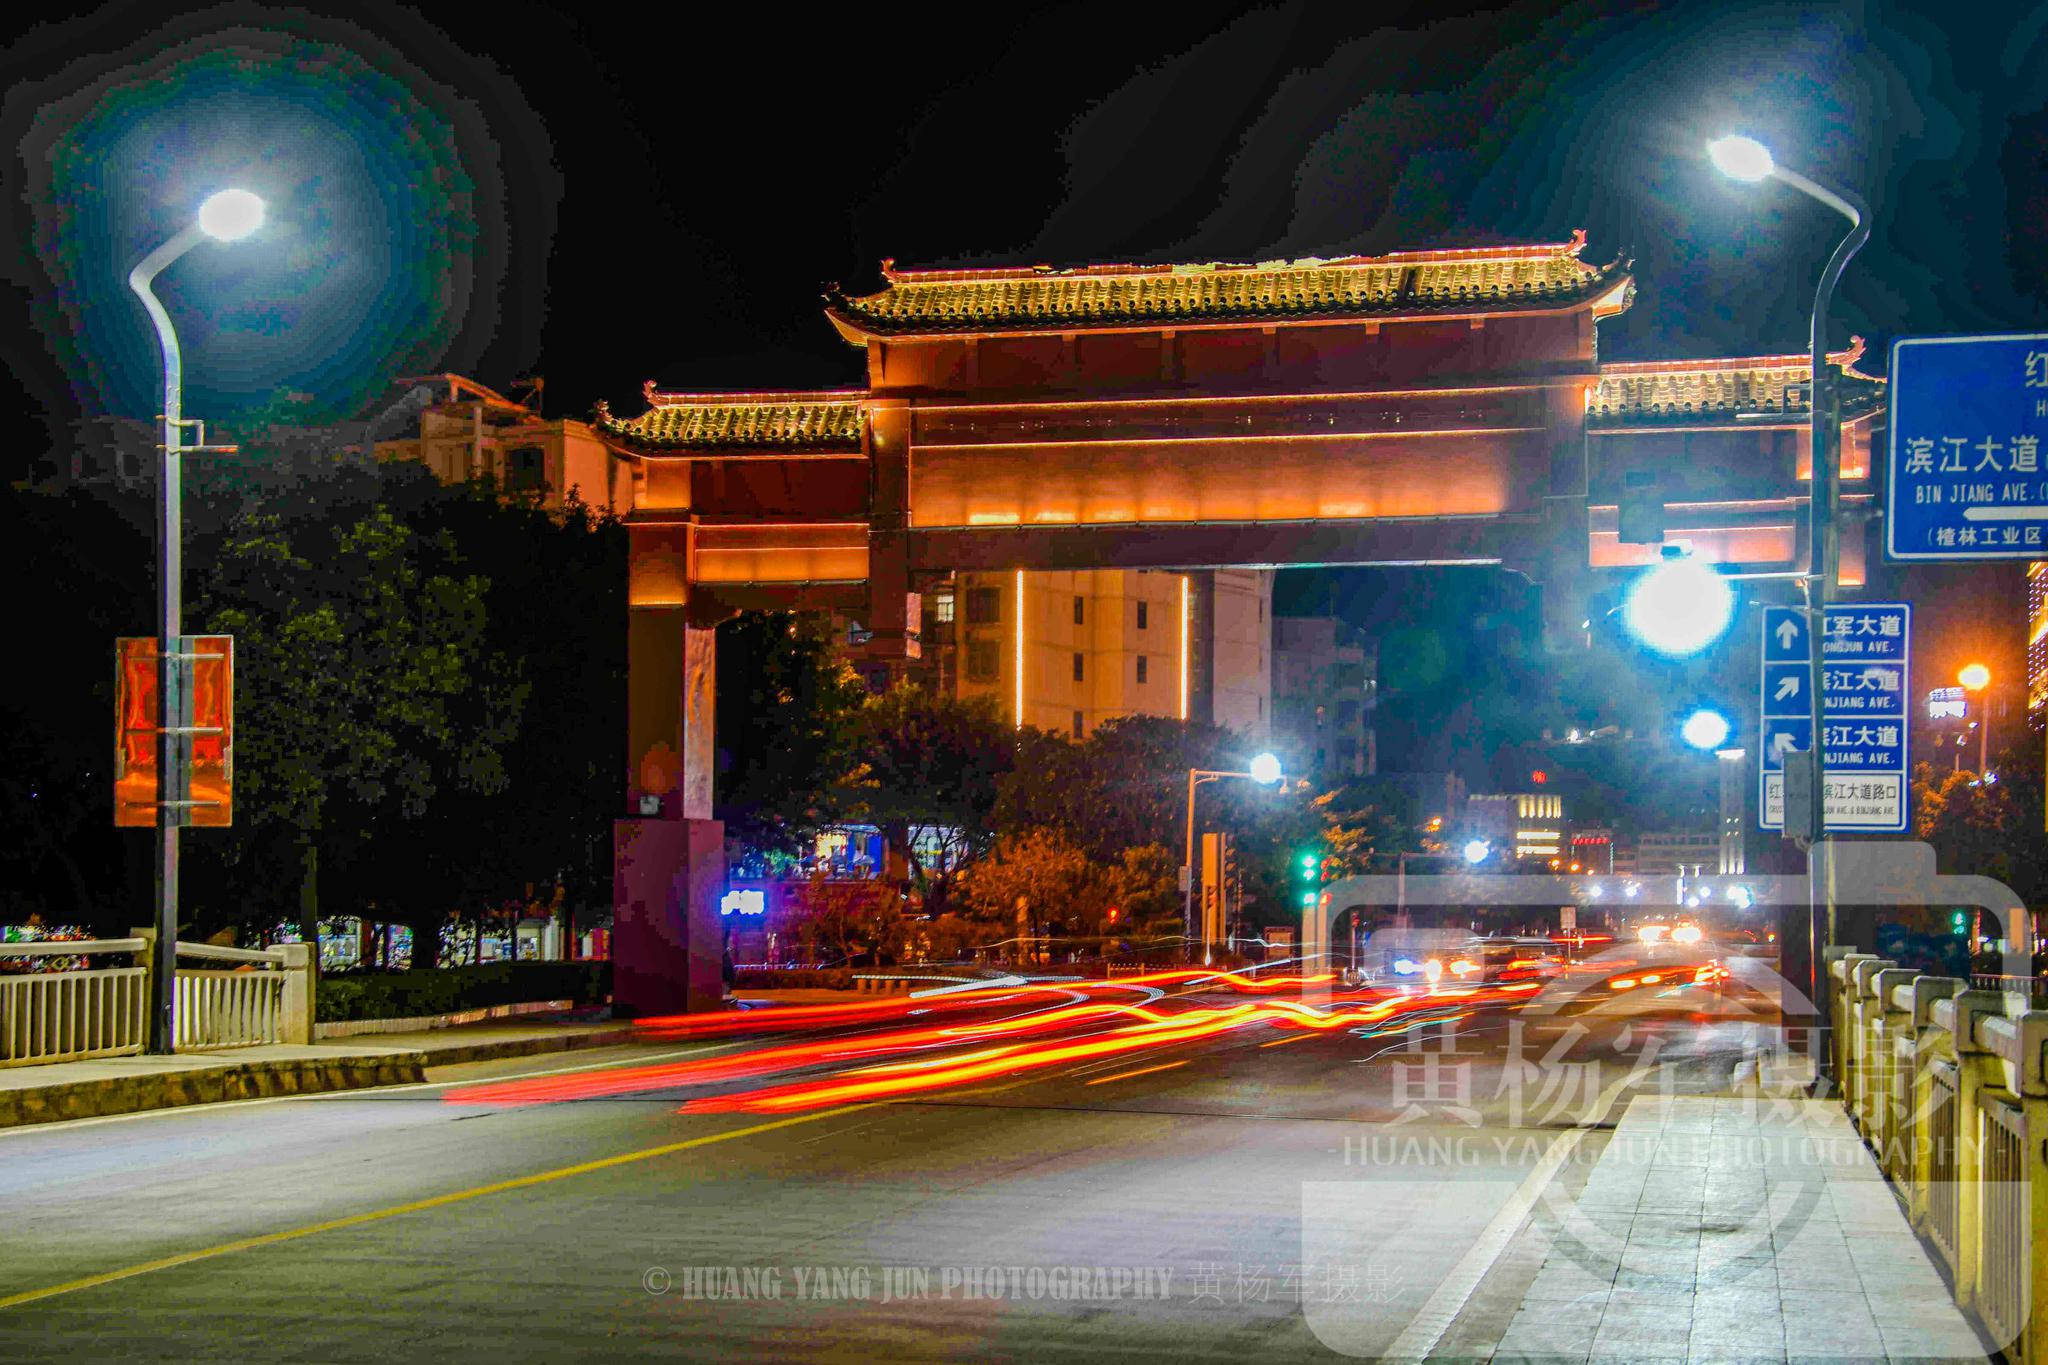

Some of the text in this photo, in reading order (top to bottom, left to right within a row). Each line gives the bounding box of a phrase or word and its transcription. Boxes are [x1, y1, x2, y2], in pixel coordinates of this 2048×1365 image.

[1905, 434, 2039, 474] 滨江大道
[1915, 485, 1942, 504] BIN
[1950, 483, 1994, 503] JIANG
[1822, 640, 1863, 653] ONGJUN
